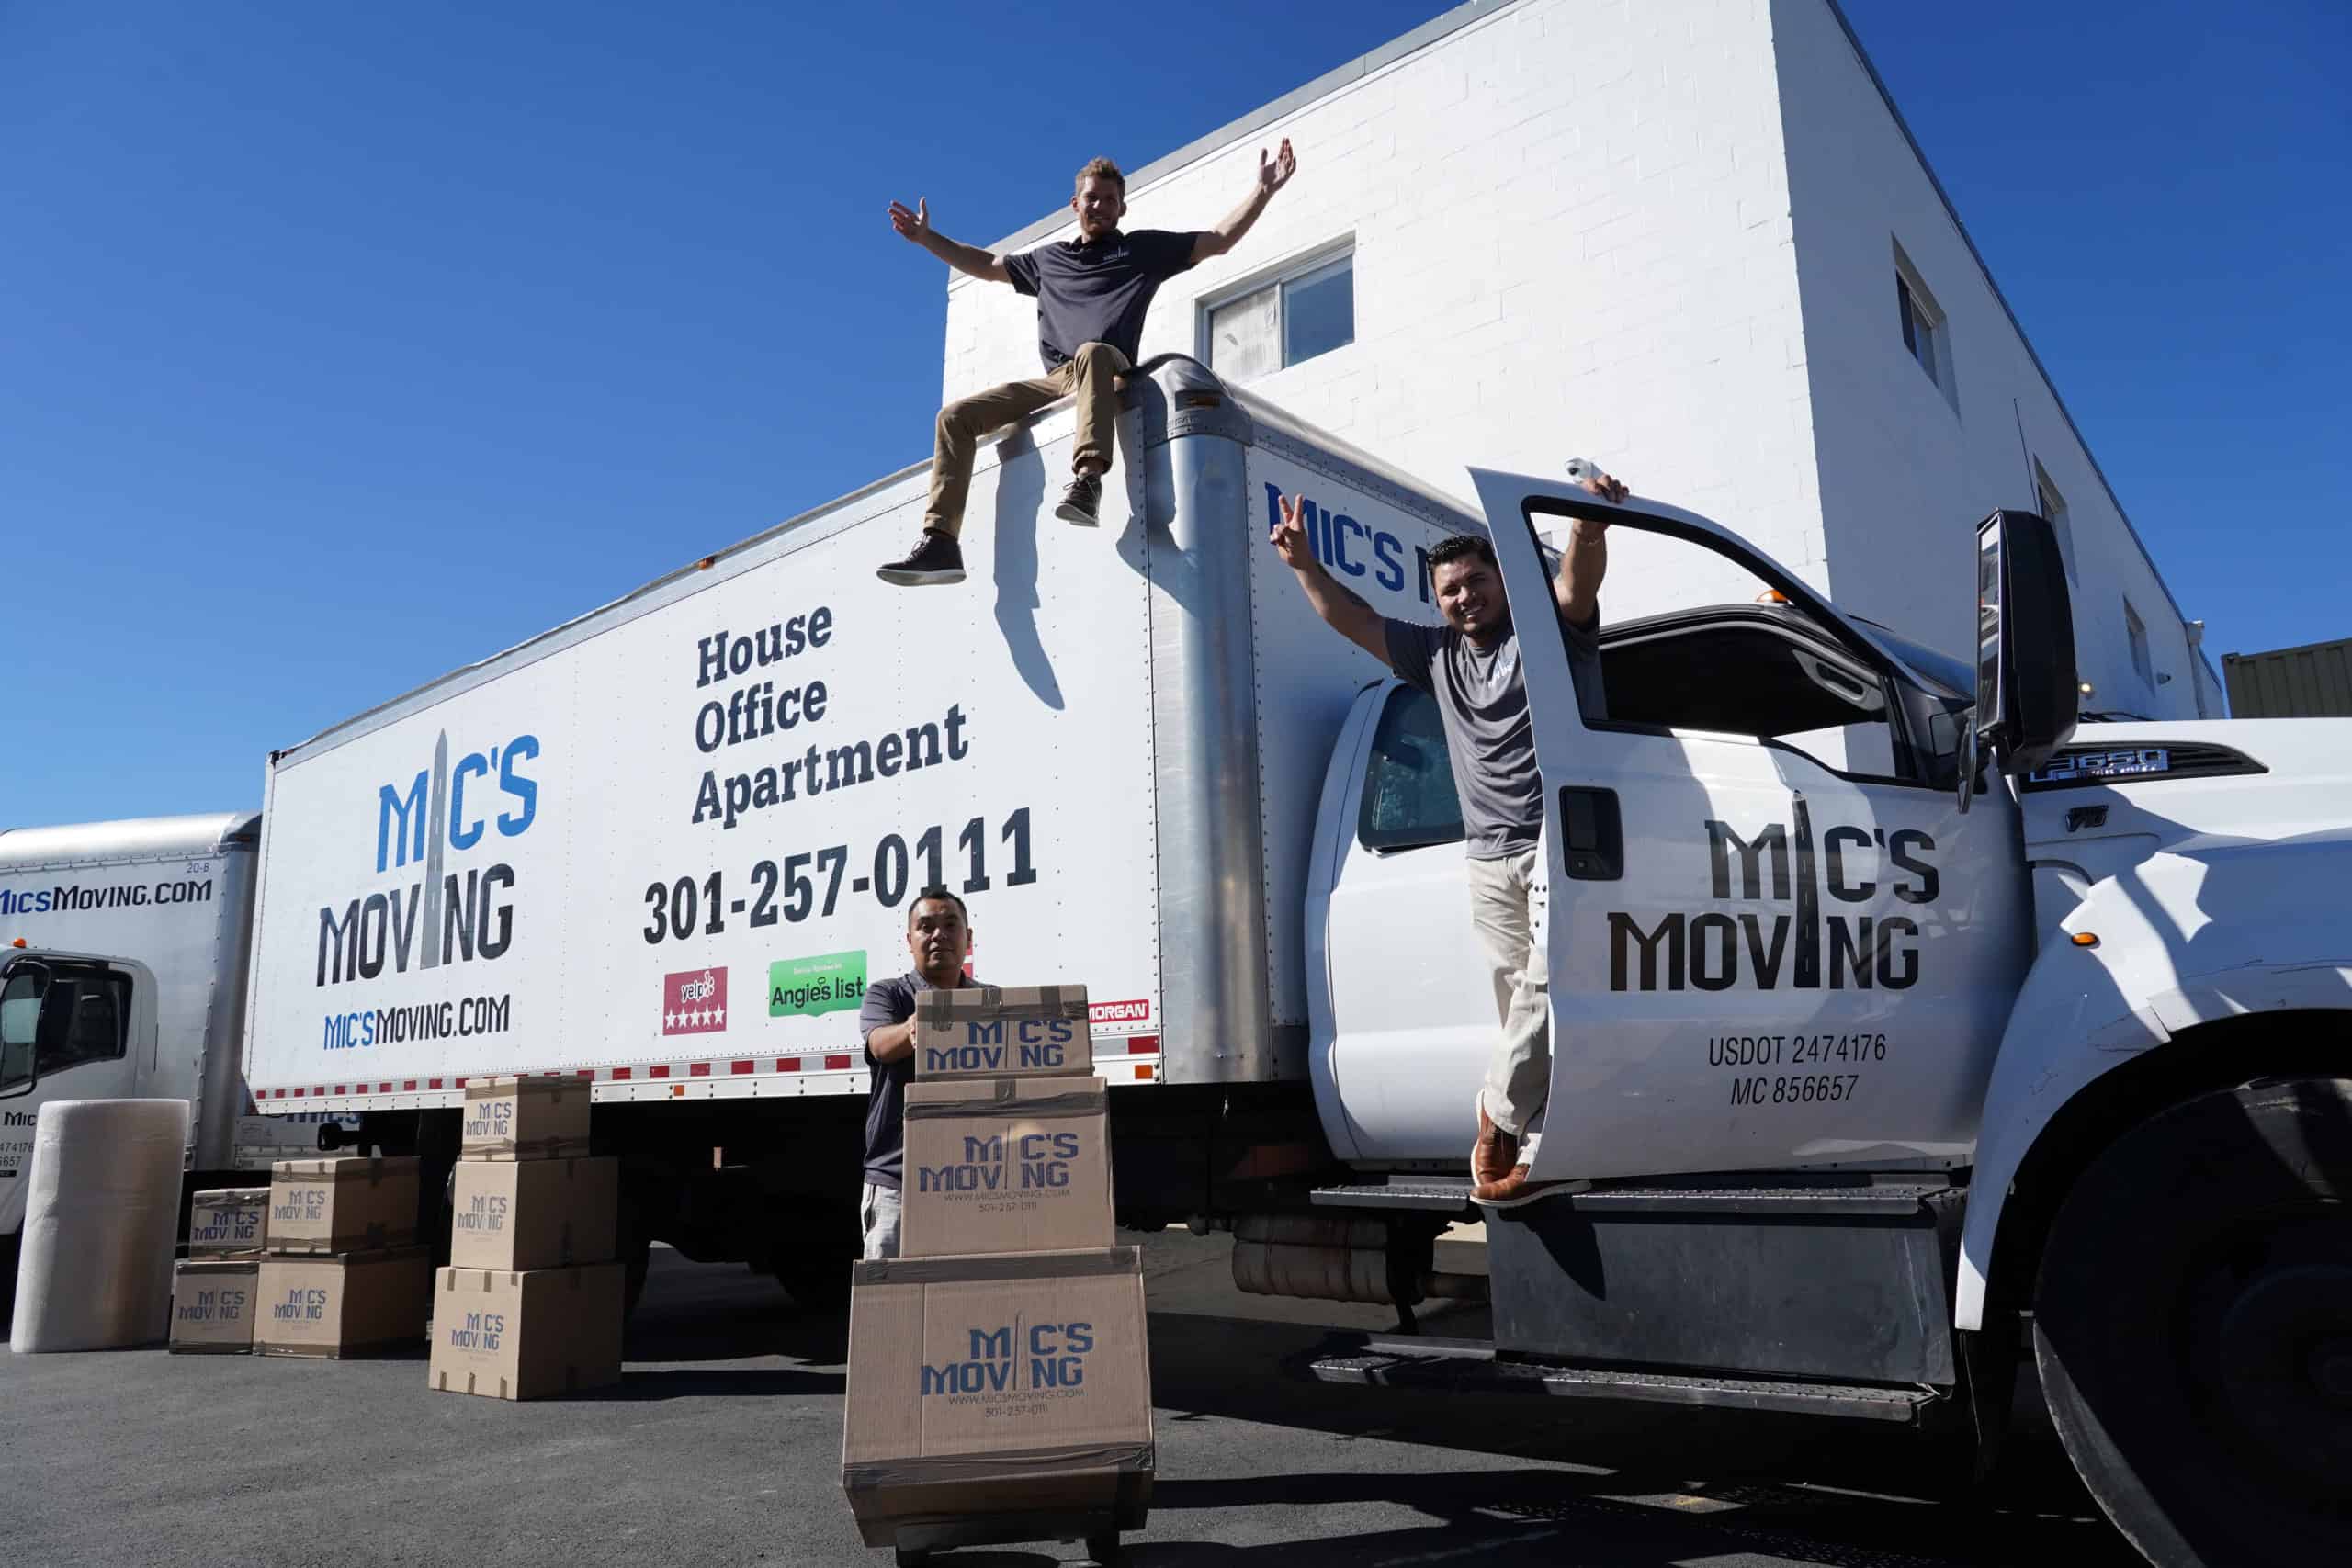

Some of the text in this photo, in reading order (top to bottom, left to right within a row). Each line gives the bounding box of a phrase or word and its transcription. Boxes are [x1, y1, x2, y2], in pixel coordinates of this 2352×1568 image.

[696, 605, 832, 688] House
[695, 681, 828, 753] Office
[692, 703, 969, 829] Apartment
[643, 807, 1037, 944] 301-257-0111
[682, 980, 704, 1002] yelp
[835, 976, 865, 999] list
[1709, 1034, 1886, 1066] USDOT 2474176
[1731, 1075, 1859, 1105] MC 856657
